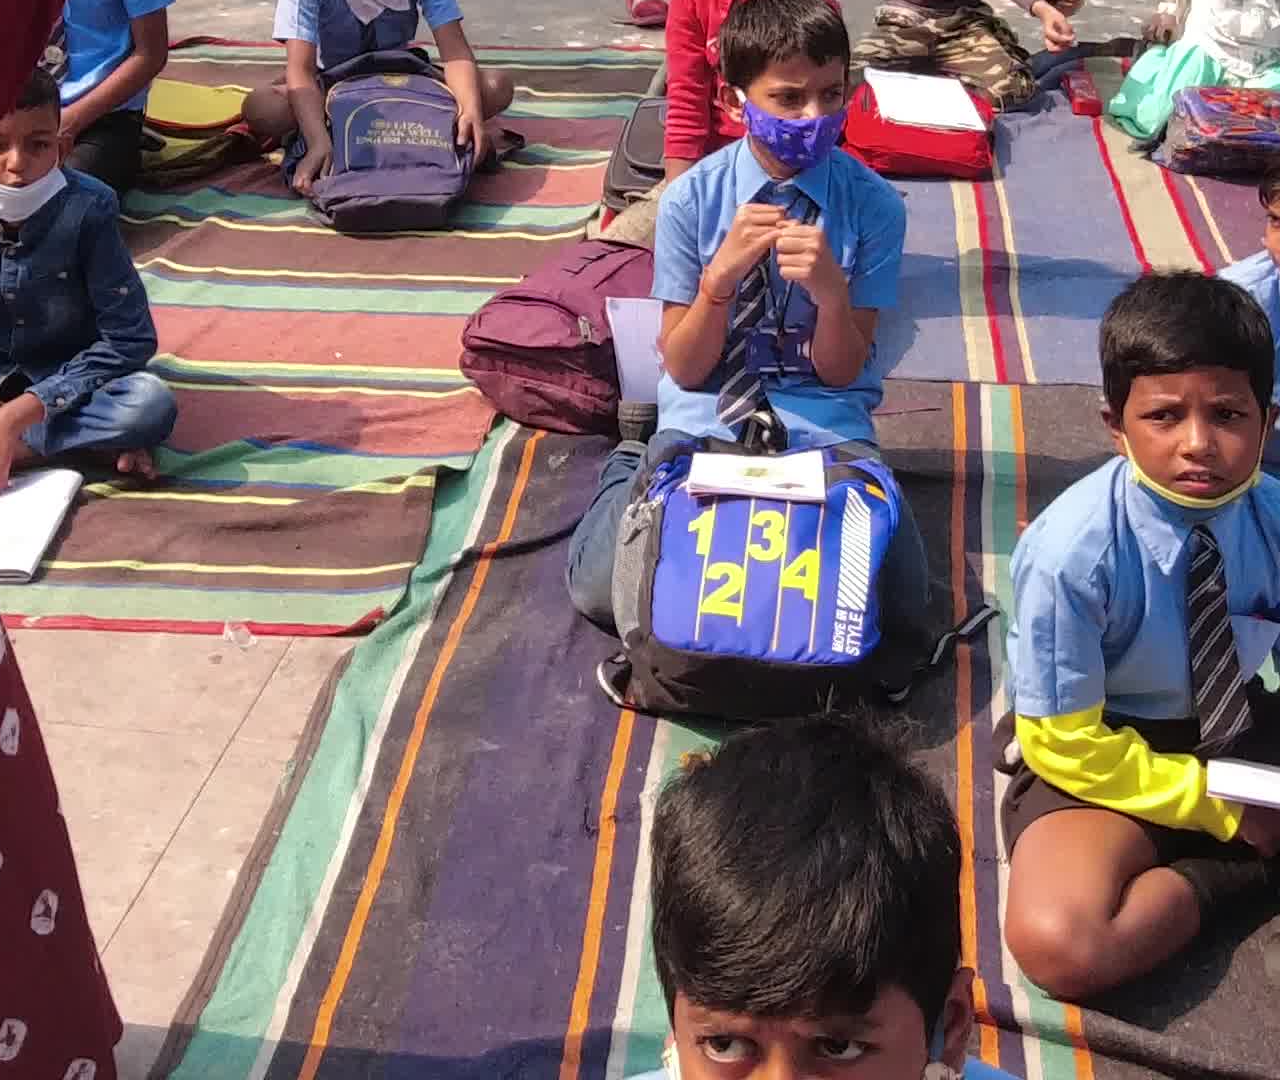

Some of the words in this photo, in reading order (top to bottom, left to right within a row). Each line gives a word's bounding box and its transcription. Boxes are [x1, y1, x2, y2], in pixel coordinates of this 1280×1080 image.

[688, 510, 715, 556] 1
[747, 510, 786, 561] 3
[700, 562, 746, 617] 2
[781, 549, 818, 600] 4
[845, 611, 864, 656] STYLE
